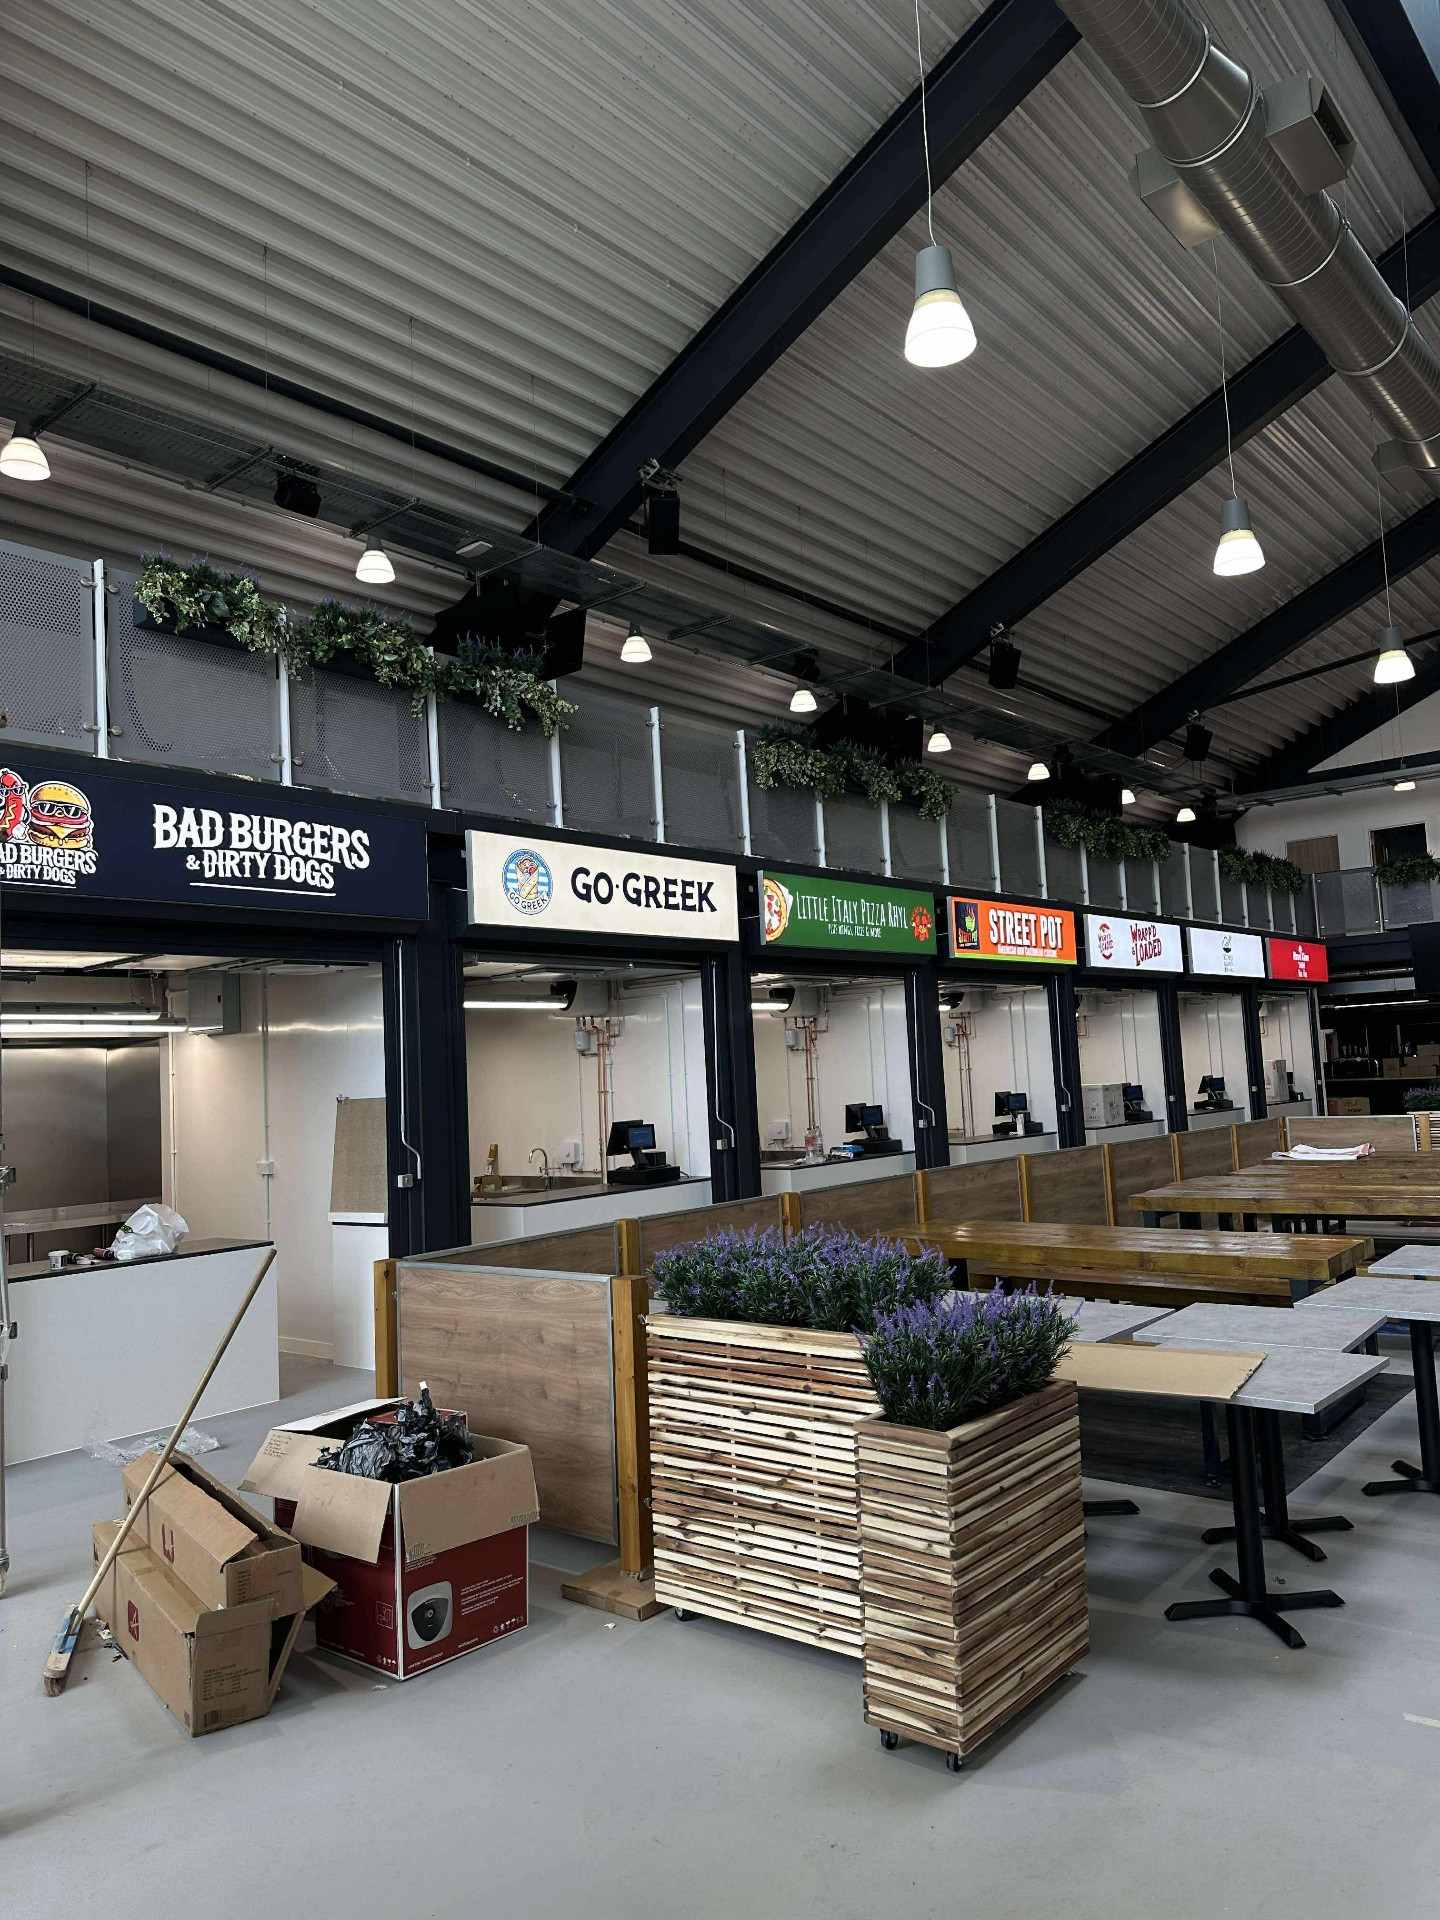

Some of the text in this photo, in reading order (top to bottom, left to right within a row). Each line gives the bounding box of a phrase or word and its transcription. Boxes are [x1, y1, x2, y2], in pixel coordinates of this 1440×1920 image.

[153, 803, 370, 870] BAD BURGERS
[6, 864, 41, 879] DIRTY
[43, 865, 76, 885] DOGS
[20, 844, 96, 875] BURGERS
[186, 849, 335, 889] & DIRTY DOGS
[521, 895, 548, 910] GREEK
[796, 890, 829, 922] LITTLE
[832, 895, 858, 924] ITALY
[861, 898, 886, 927] PIZZA
[888, 901, 909, 929] RHYL
[988, 908, 1063, 949] STREET POT
[1135, 938, 1162, 966] LOADED
